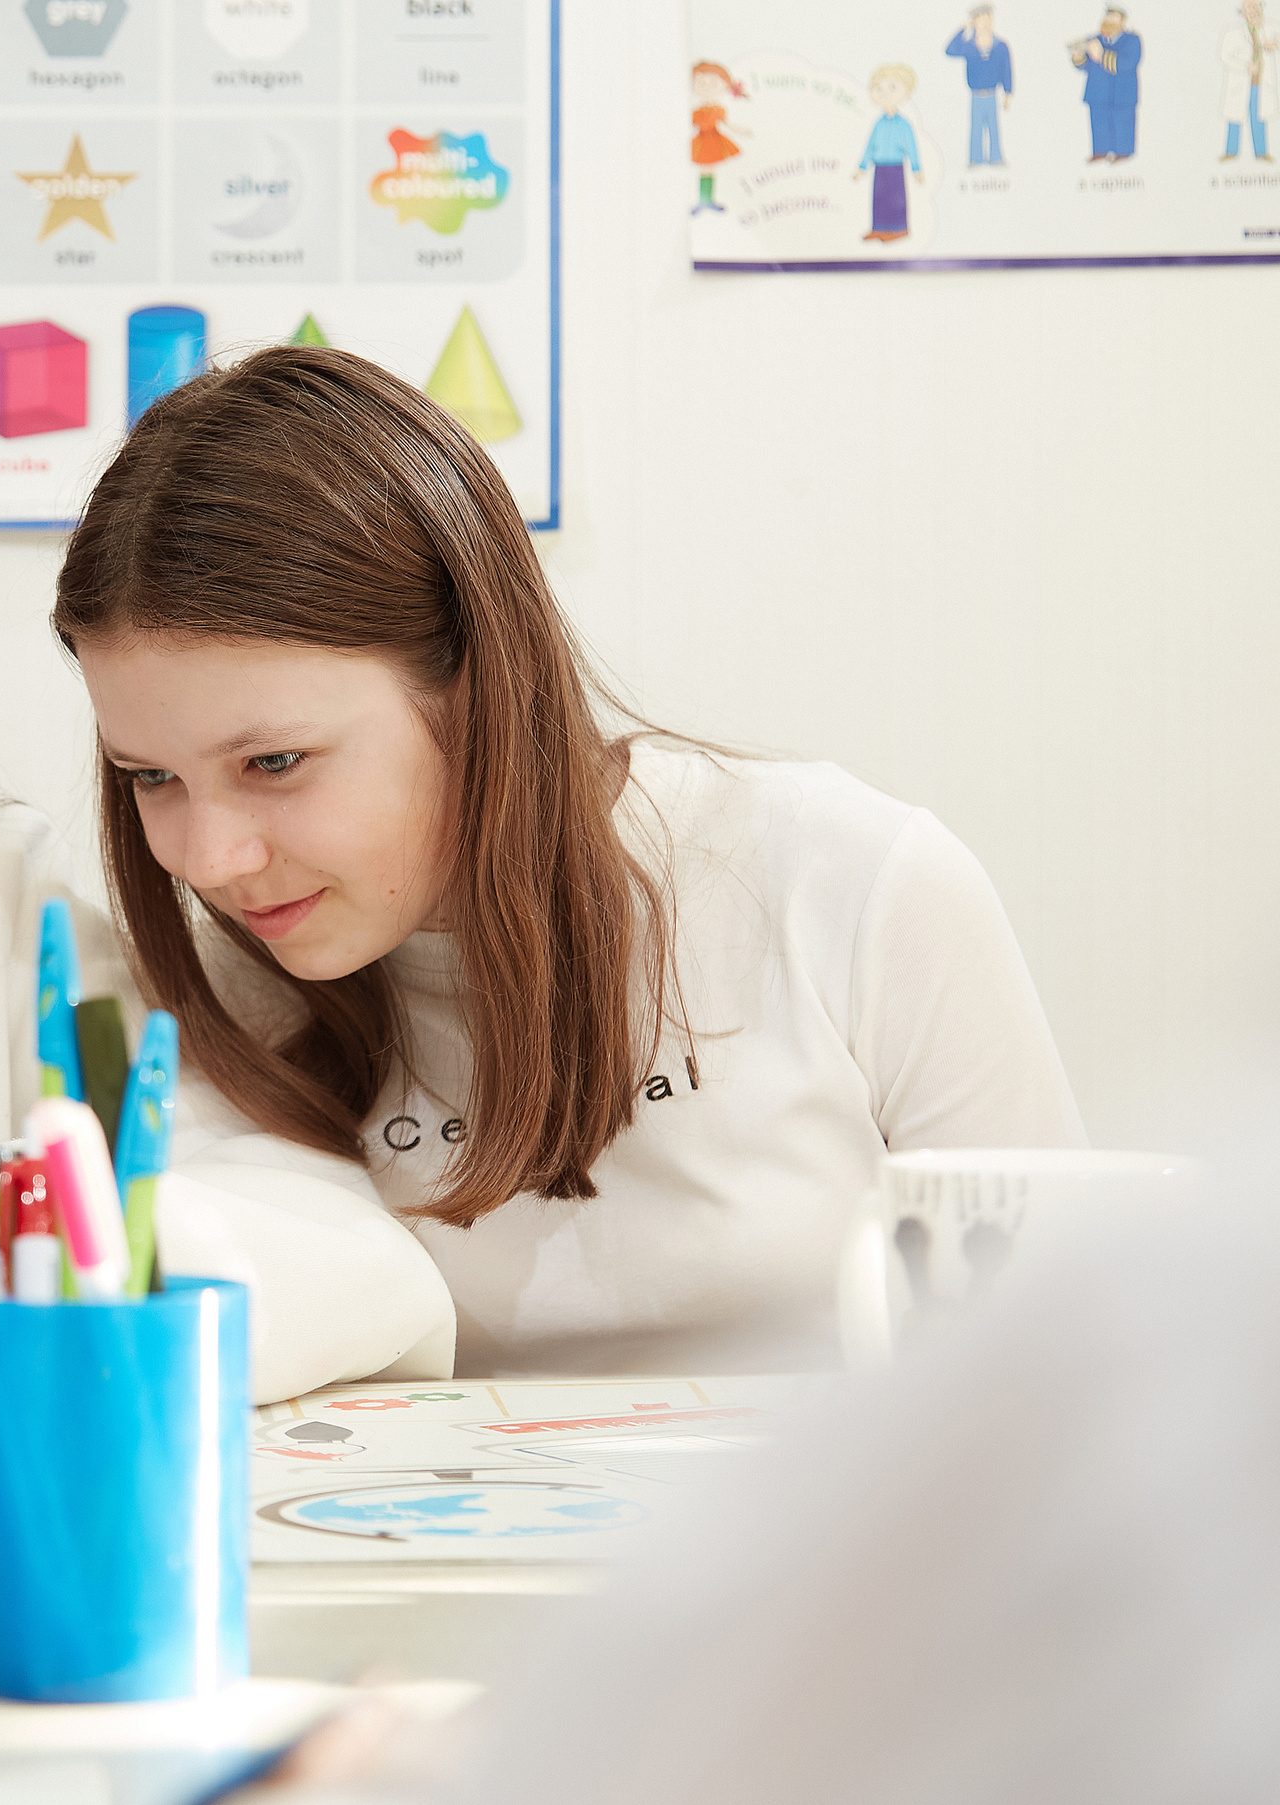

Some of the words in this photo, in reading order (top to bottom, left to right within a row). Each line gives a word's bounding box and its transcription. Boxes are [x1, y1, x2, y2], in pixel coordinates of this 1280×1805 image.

[406, 0, 474, 16] black
[28, 71, 125, 92] hexagon
[211, 68, 304, 89] octagon
[420, 66, 460, 85] line
[225, 174, 291, 197] silver
[381, 171, 498, 200] coloured
[55, 250, 95, 267] star
[210, 247, 305, 266] crescent
[416, 247, 463, 268] spot
